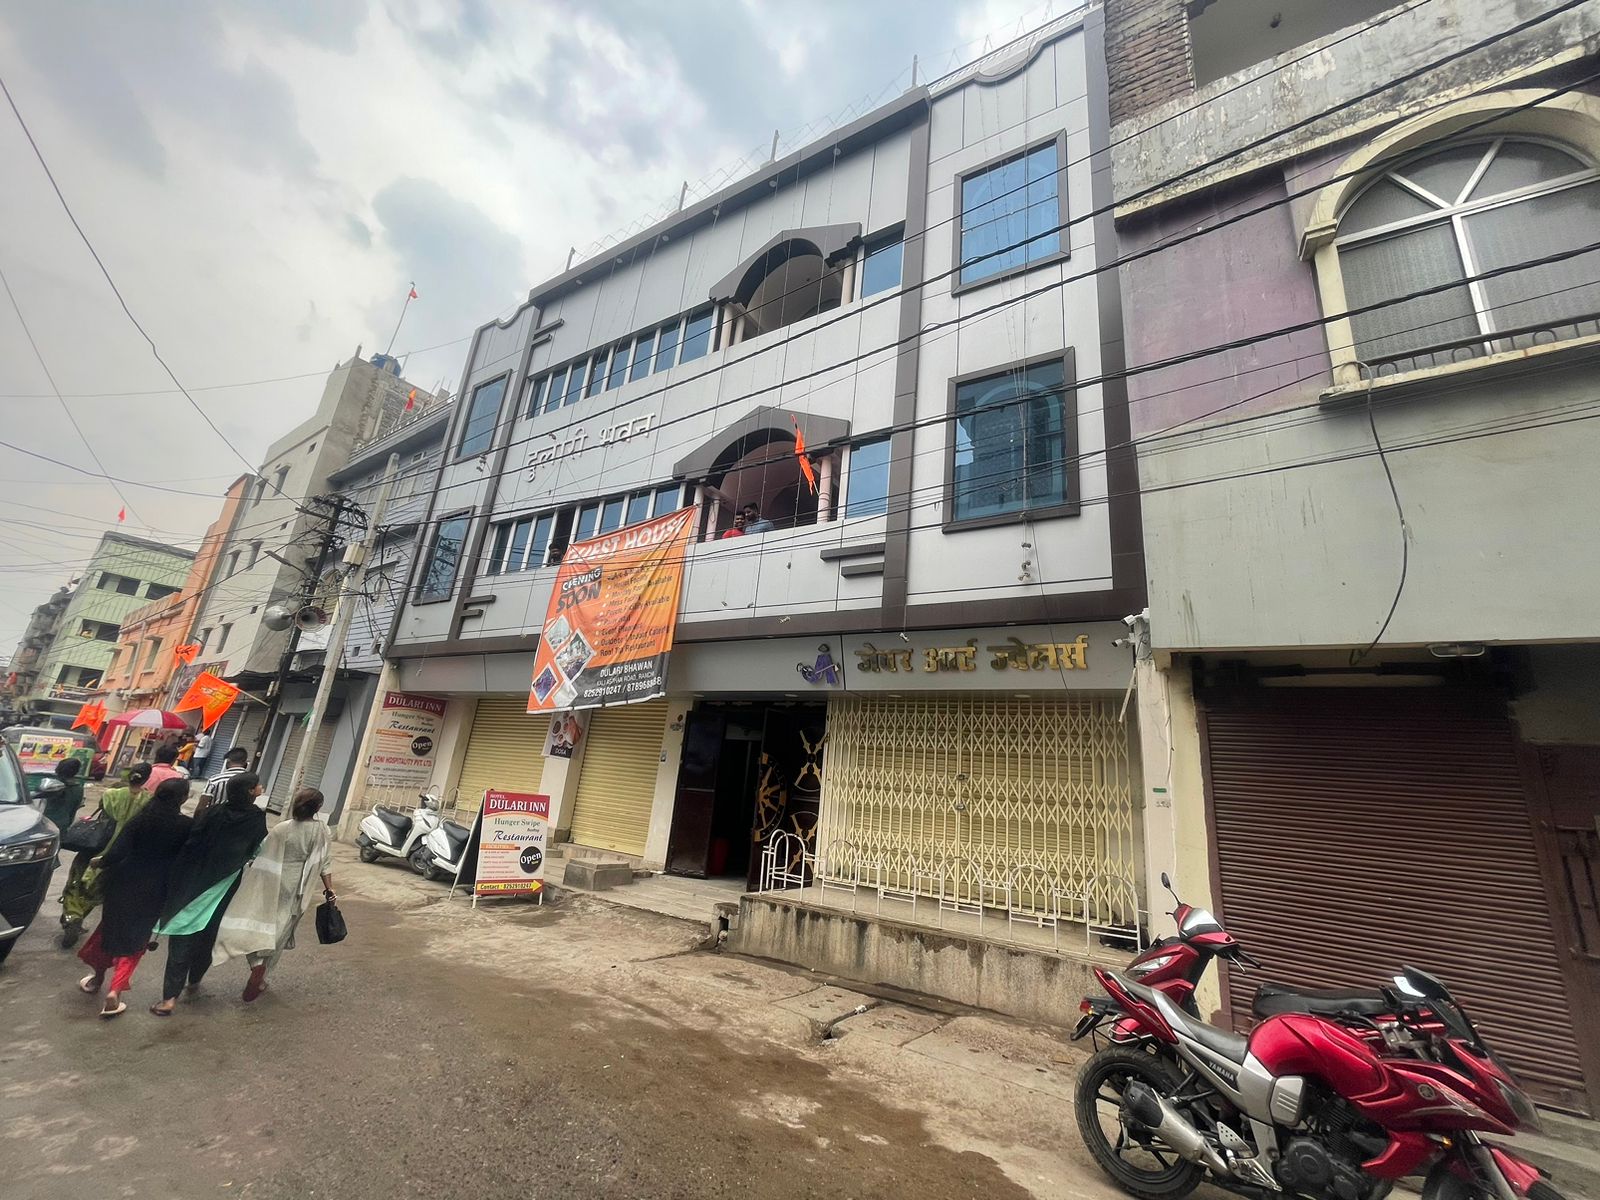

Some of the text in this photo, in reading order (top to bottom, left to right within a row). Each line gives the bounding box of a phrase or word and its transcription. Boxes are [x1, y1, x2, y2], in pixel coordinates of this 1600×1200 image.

[562, 568, 601, 591] OPENING
[624, 660, 653, 673] BHAWAN
[388, 696, 442, 711] DULARI INN
[489, 799, 547, 812] DULARI INN
[494, 817, 540, 827] Hunger Swipe
[493, 830, 543, 842] Restaurant
[520, 852, 541, 865] Open
